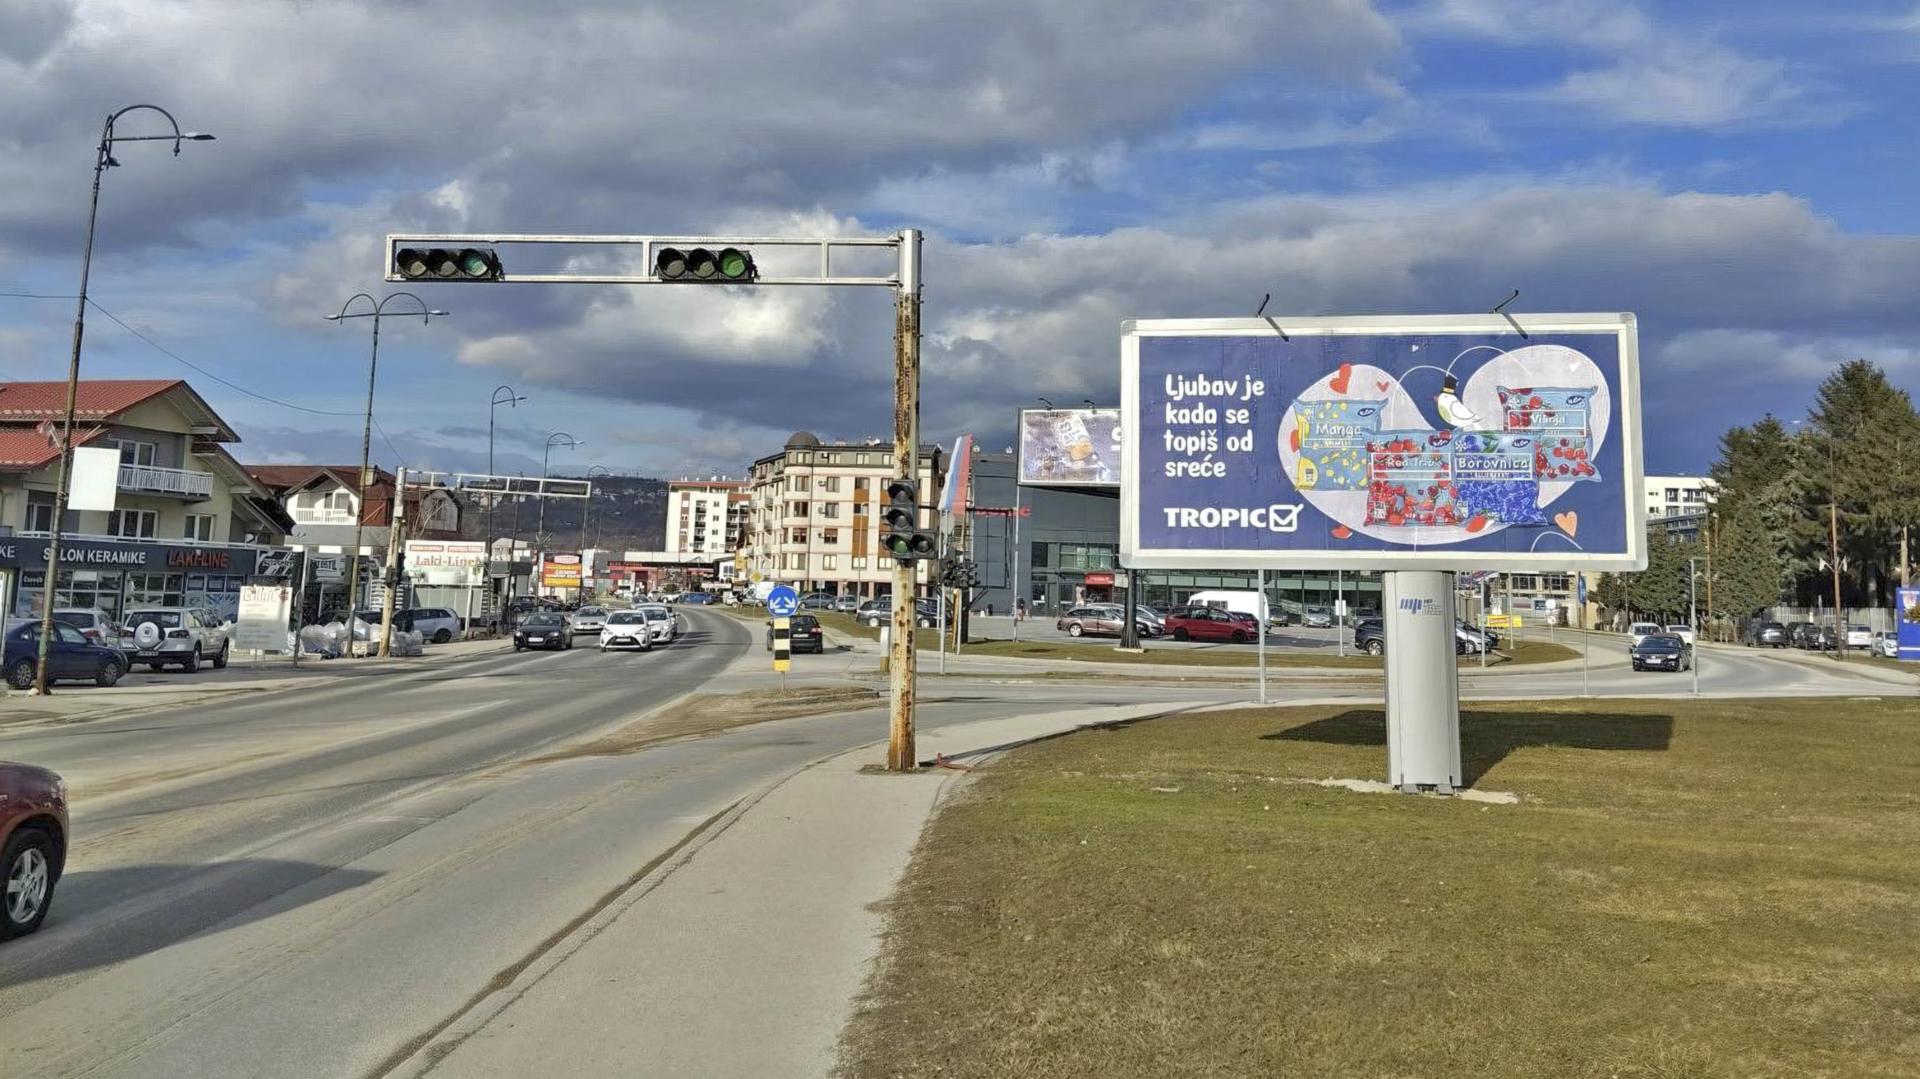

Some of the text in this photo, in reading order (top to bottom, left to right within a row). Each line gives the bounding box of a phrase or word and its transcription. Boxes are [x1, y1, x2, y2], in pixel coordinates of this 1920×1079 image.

[1165, 374, 1265, 401] Ljubav je
[1165, 402, 1250, 424] kada se
[1316, 423, 1362, 439] Mango
[1163, 429, 1253, 456] topiš od
[1165, 454, 1226, 477] sreće
[1458, 458, 1528, 469] Borovnica
[1163, 507, 1267, 527] TROPIC
[43, 547, 147, 564] SLON KERAMIKE
